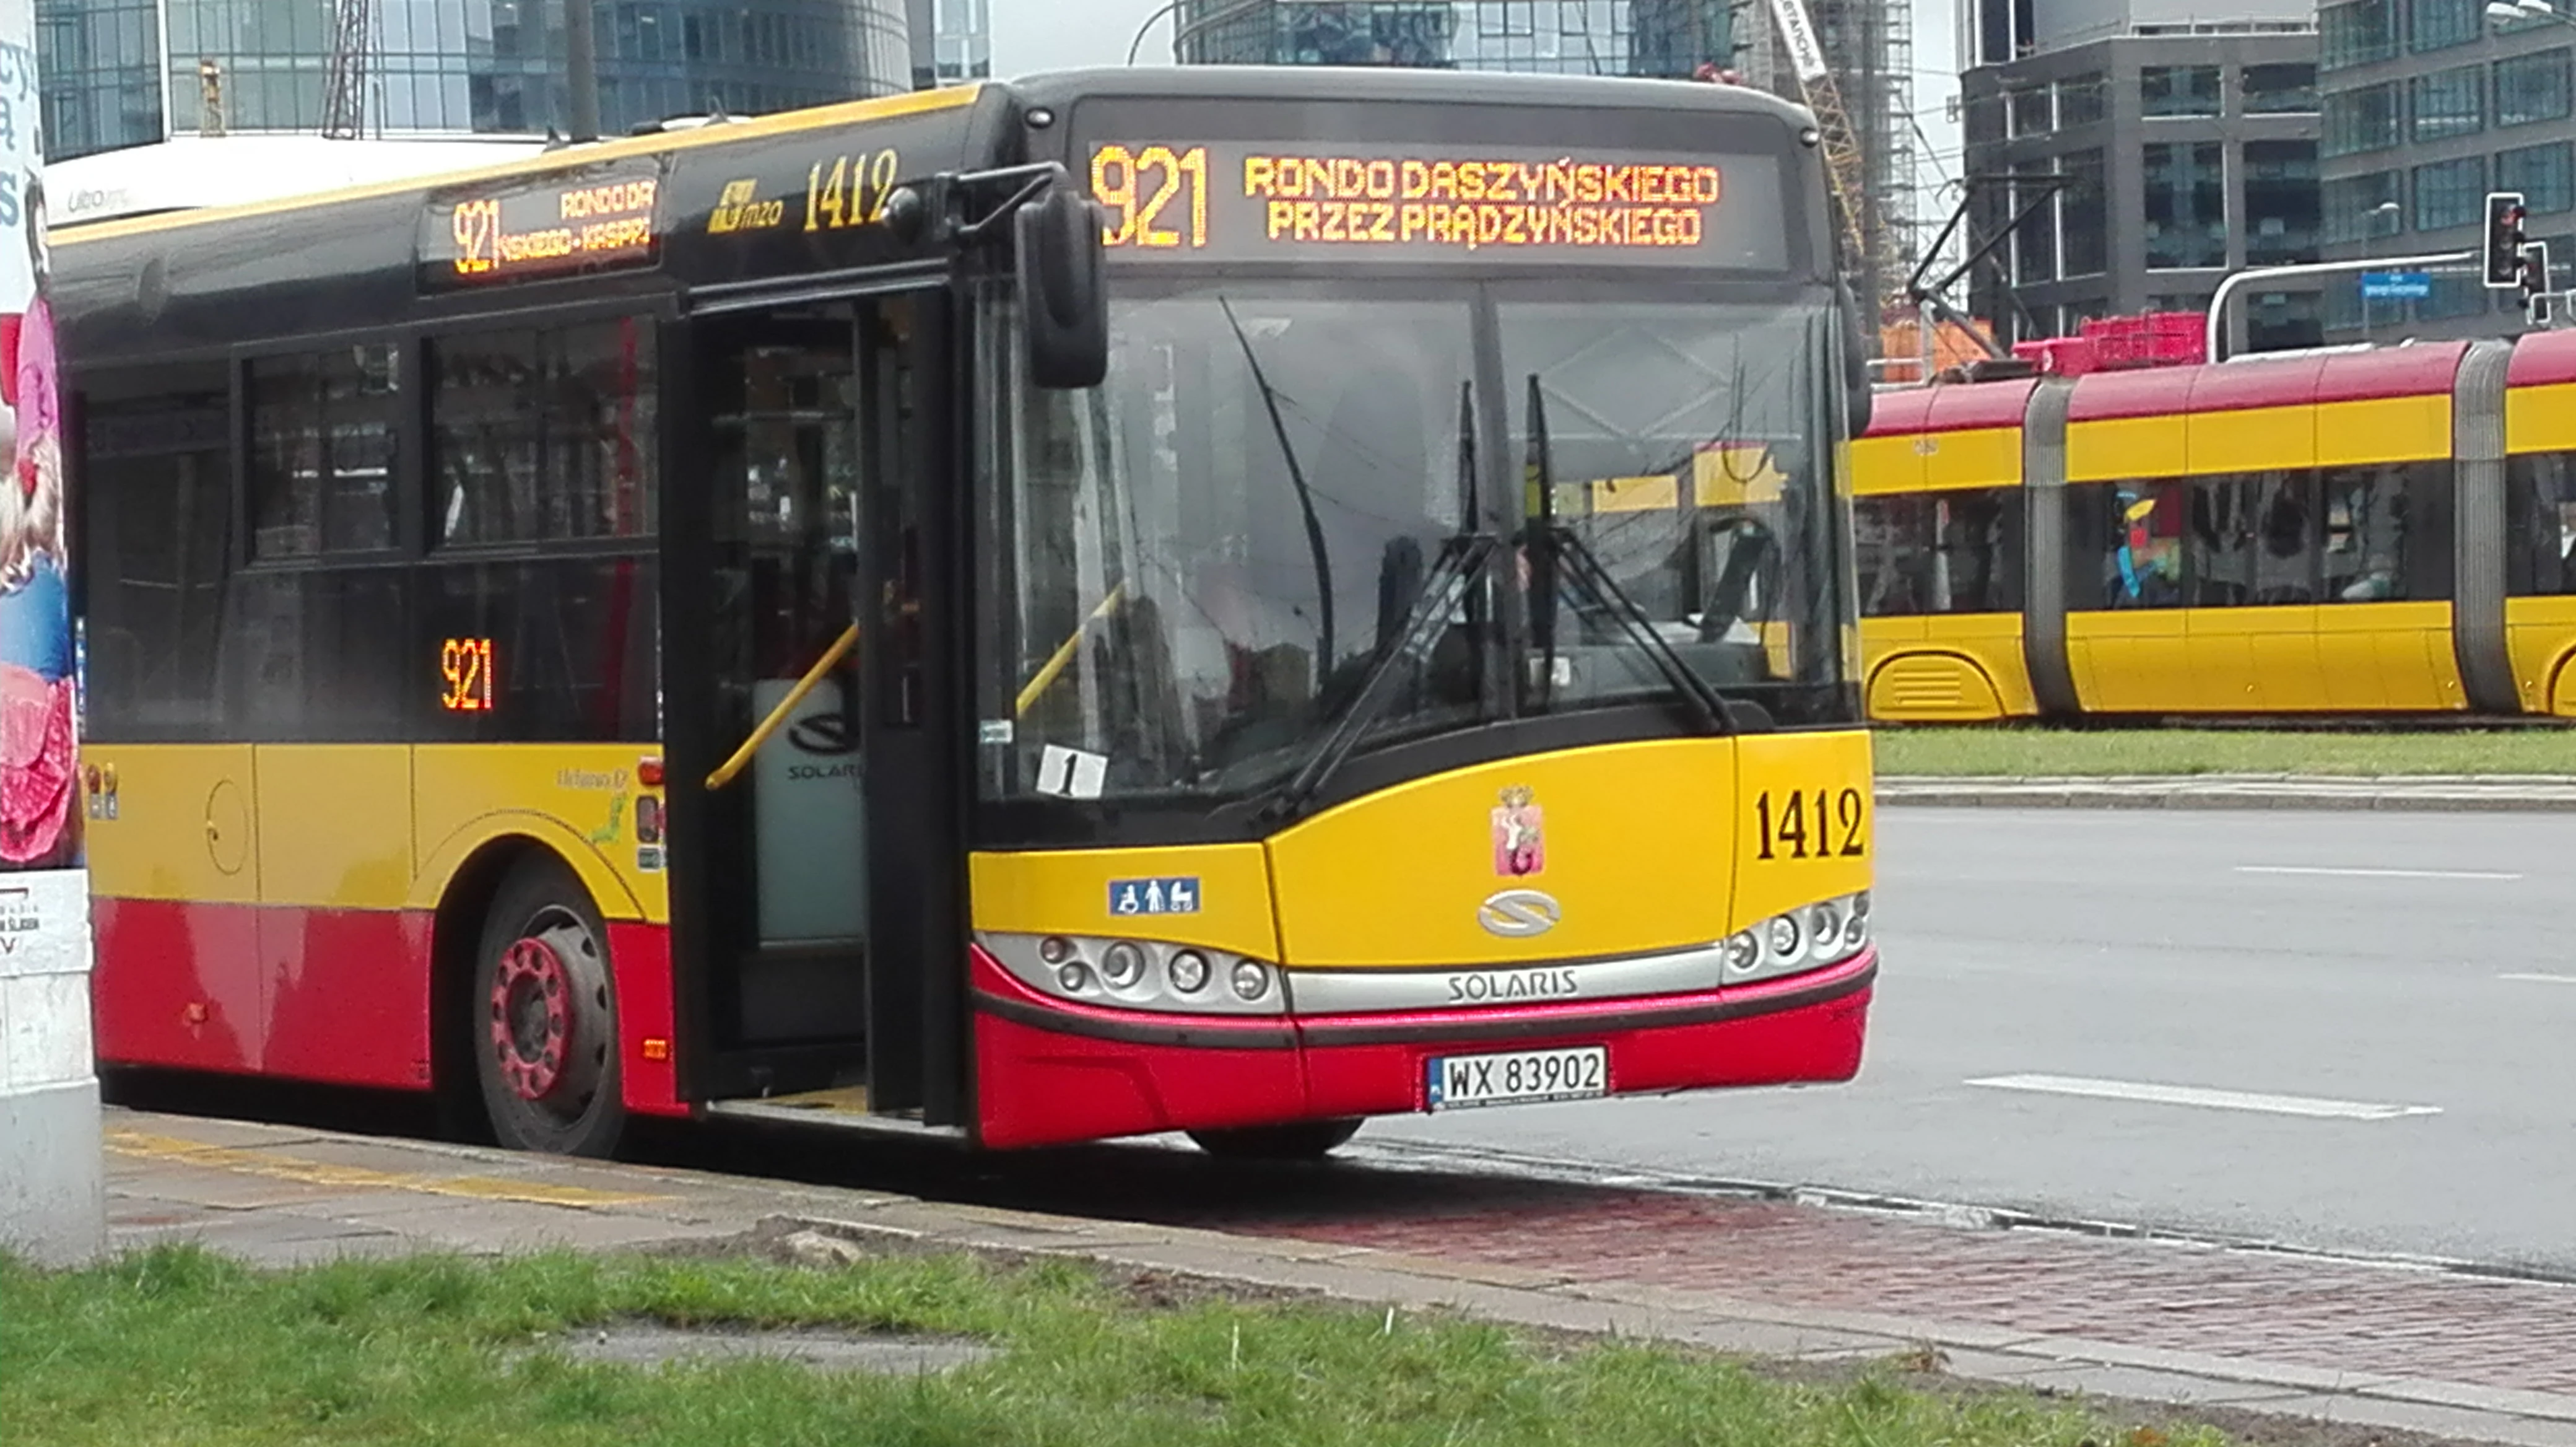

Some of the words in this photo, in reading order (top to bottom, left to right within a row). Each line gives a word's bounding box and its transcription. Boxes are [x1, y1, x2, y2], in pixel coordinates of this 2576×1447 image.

[804, 148, 897, 232] 1412
[1092, 146, 1208, 247] 921
[1245, 156, 1395, 199] RONDO
[1401, 156, 1720, 204] DASZYŃSKIEGO
[454, 200, 499, 274] 921
[1267, 200, 1395, 242] PRZEZ
[1400, 199, 1703, 250] PRĄDZYŃSKIEGO
[442, 638, 491, 709] 921
[1060, 753, 1078, 796] 1
[1756, 787, 1863, 860] 1412
[1448, 969, 1578, 1002] SOLARIS
[1448, 1059, 1493, 1097] WX
[1506, 1053, 1601, 1093] 83902
